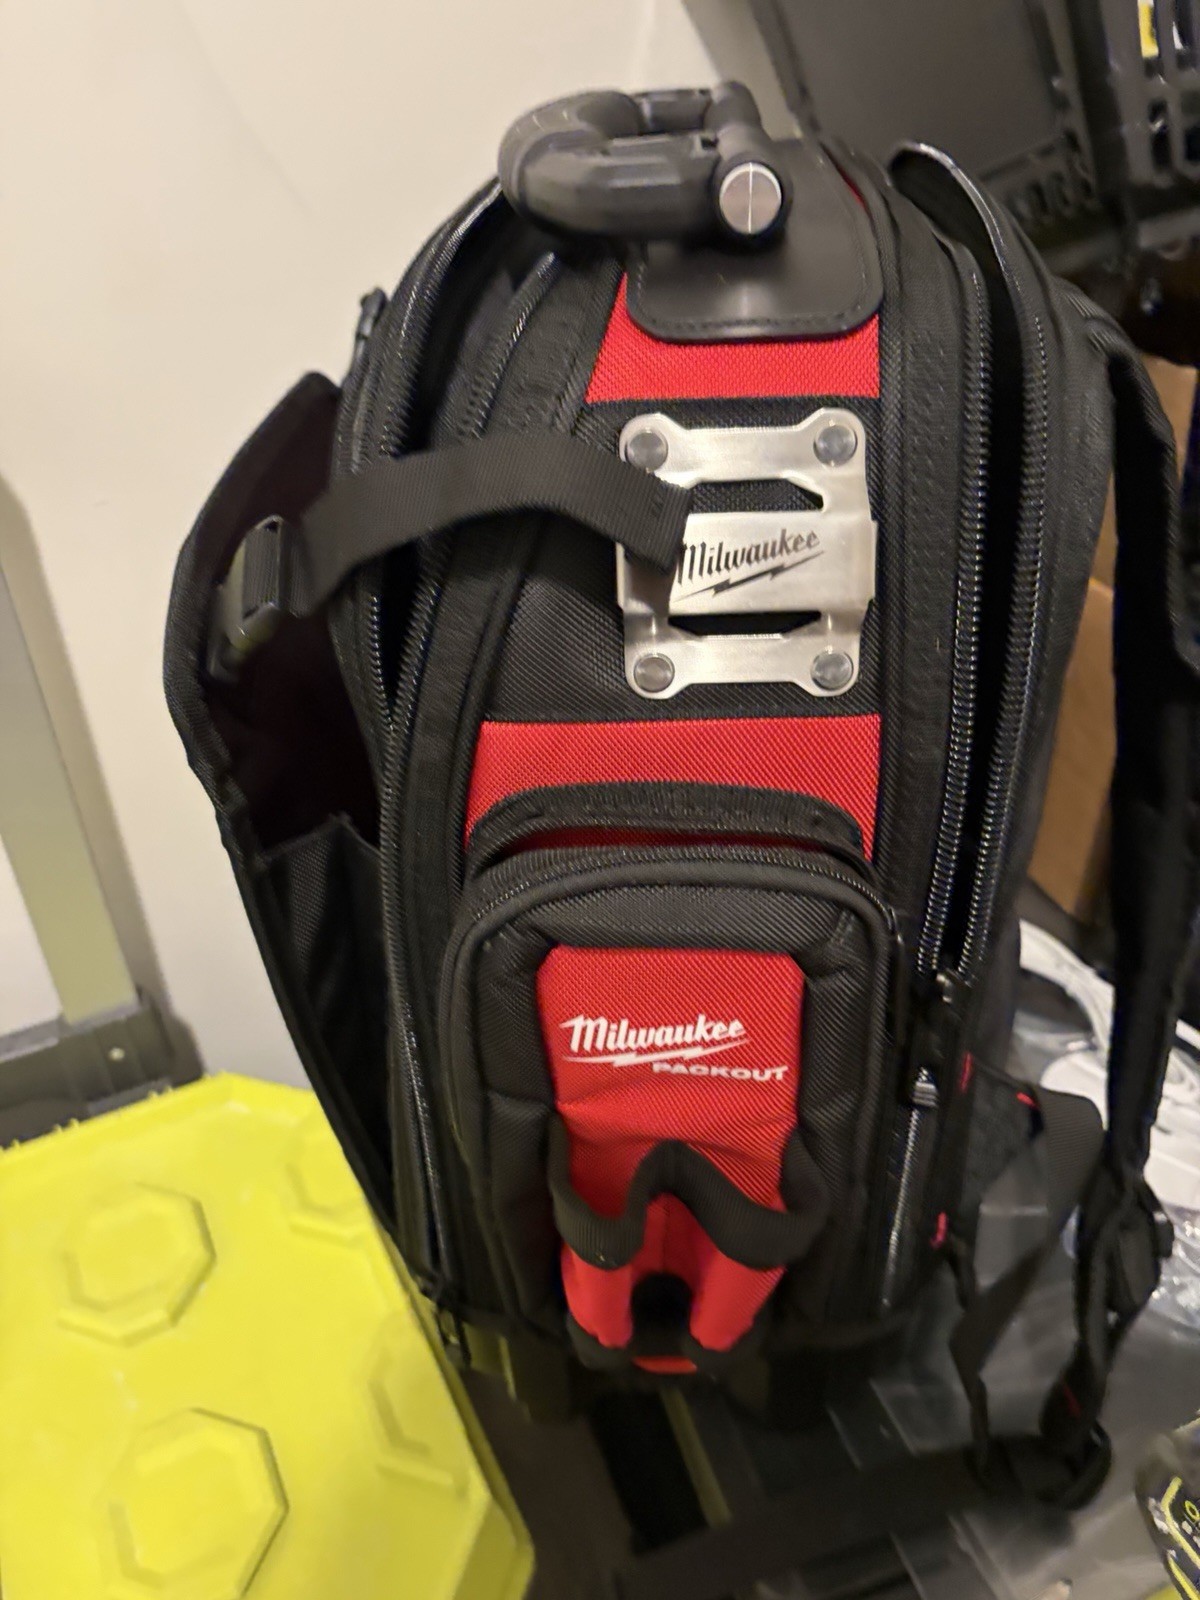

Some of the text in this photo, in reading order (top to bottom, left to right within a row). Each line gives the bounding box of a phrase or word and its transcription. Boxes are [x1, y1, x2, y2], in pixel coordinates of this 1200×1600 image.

[675, 527, 822, 585] Milwaukee
[560, 1014, 747, 1053] Milwaukee
[653, 1061, 788, 1081] PACKOUT
